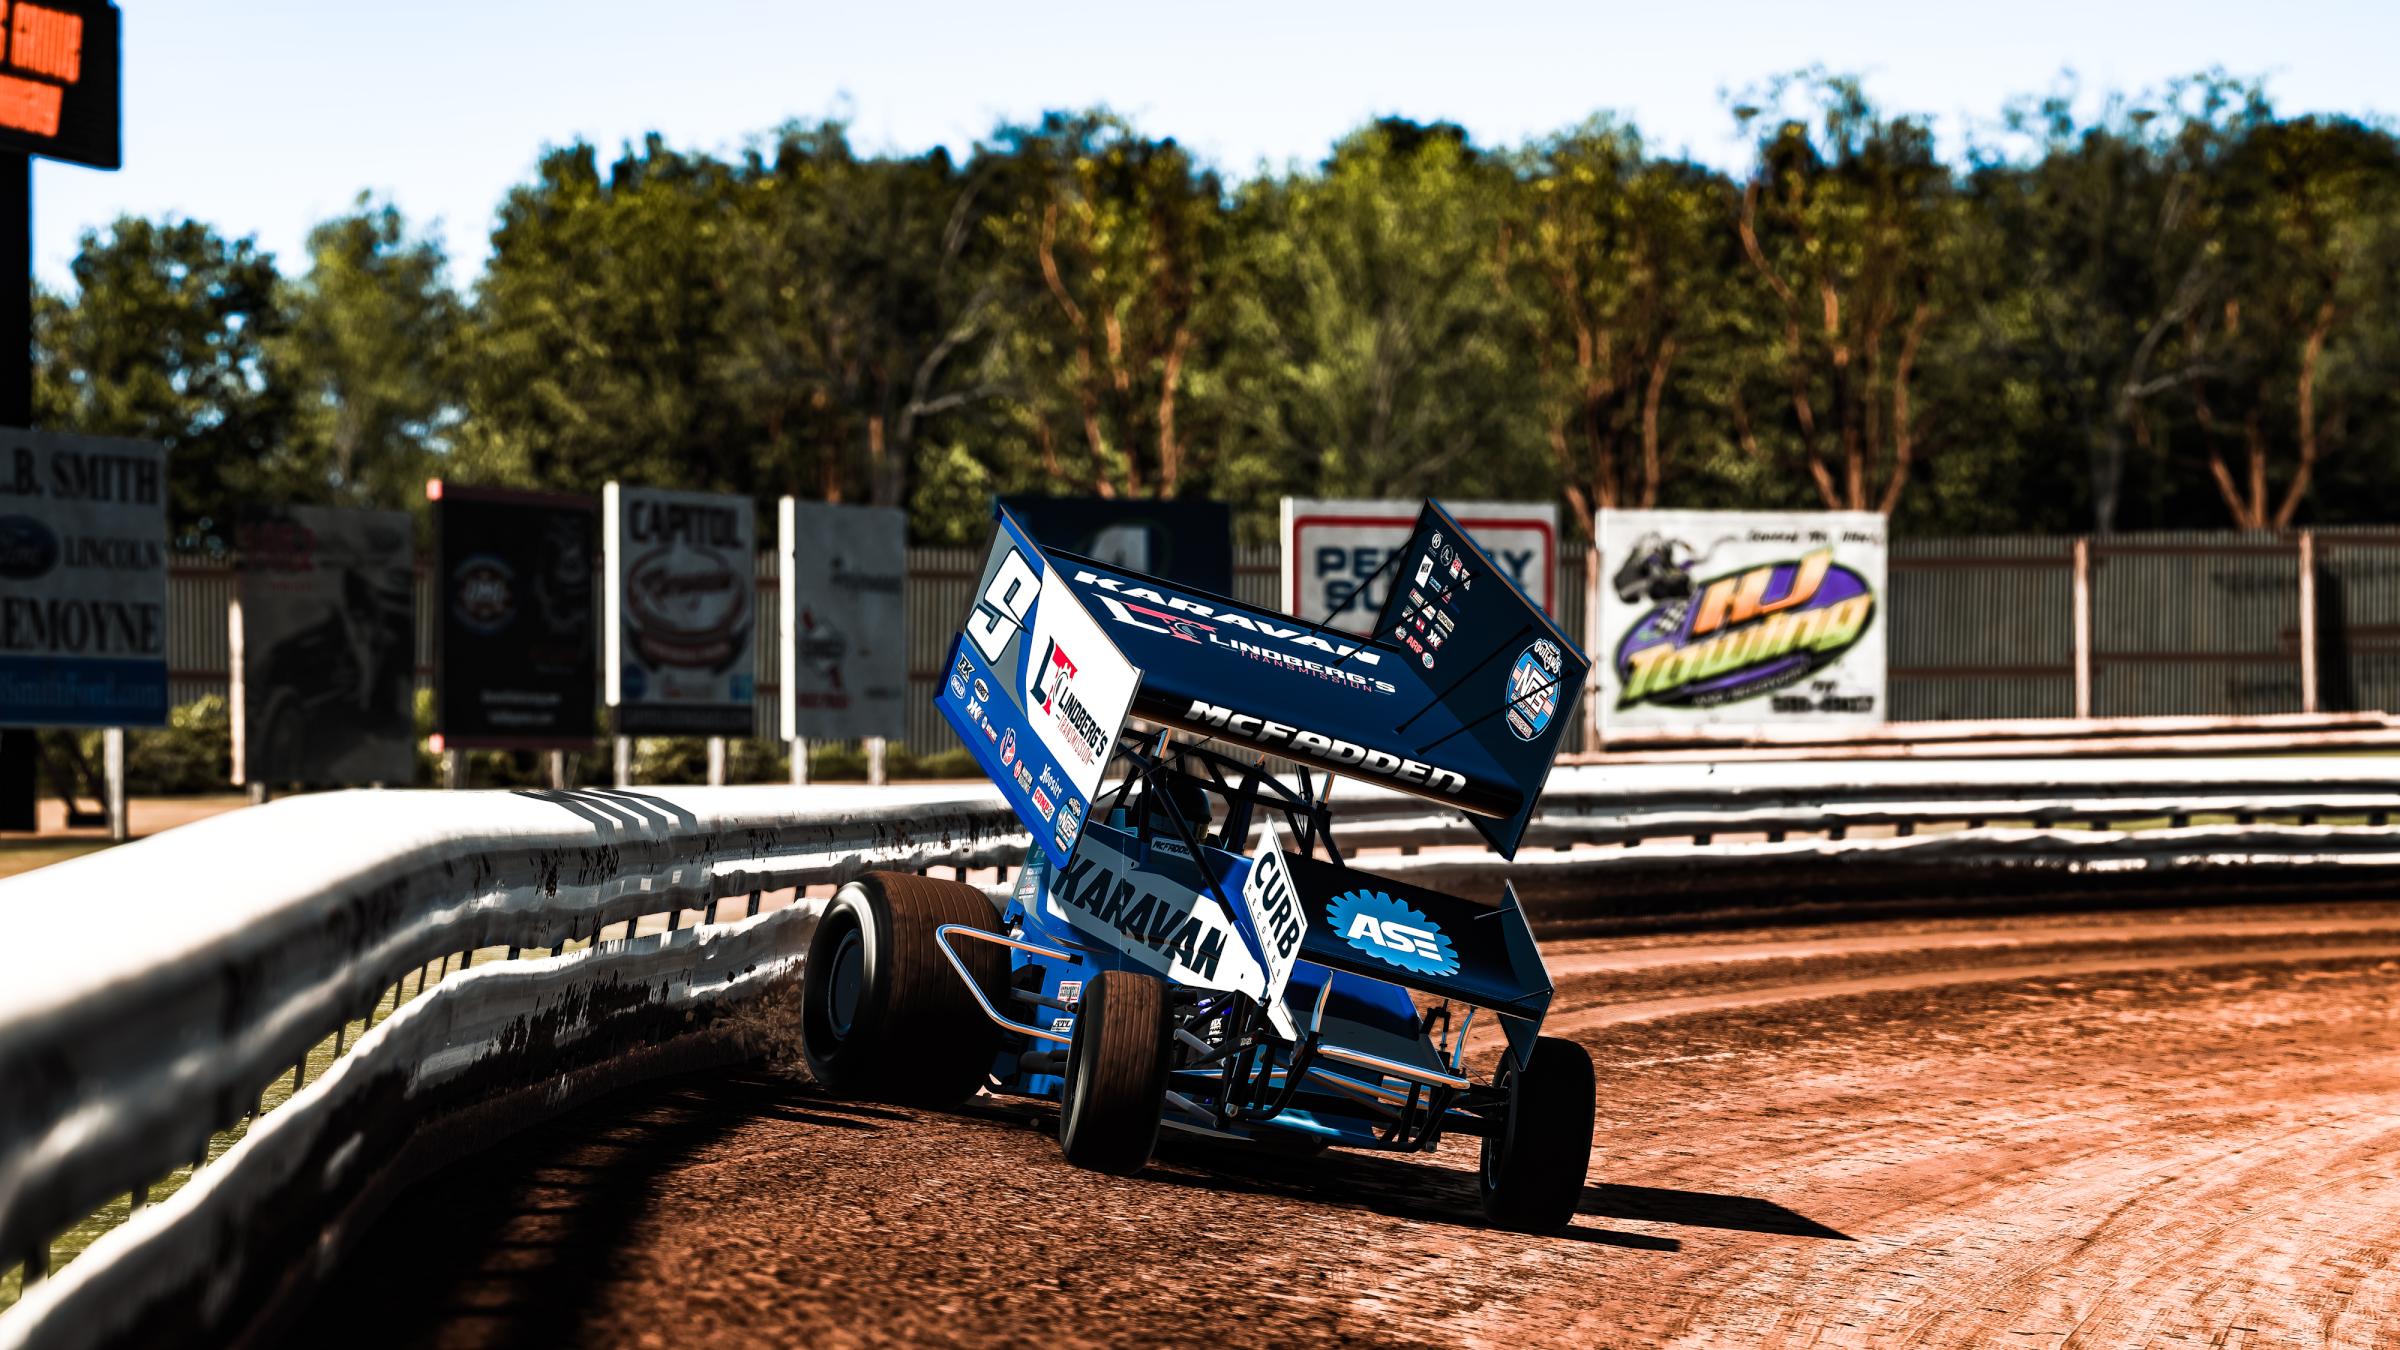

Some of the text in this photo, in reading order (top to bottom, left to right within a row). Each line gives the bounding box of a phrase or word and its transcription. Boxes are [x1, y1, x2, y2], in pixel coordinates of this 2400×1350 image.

[50, 451, 159, 504] SMITH
[628, 499, 743, 548] CAPITOL
[63, 536, 160, 571] LINCOLN
[0, 597, 162, 653] EMOYNE
[966, 545, 1042, 666] 9
[1074, 569, 1381, 666] KARAVAN
[1208, 633, 1397, 695] LINDBERG'S
[1406, 634, 1424, 654] ARP
[1626, 594, 1874, 700] Towing
[1240, 649, 1373, 694] TRANSMISSION
[1057, 686, 1110, 758] LINDBERG'S
[1034, 788, 1051, 811] COMP
[1039, 763, 1063, 800] Hoosier
[1051, 853, 1228, 982] KARAVAN
[1254, 851, 1300, 960] CURB
[1347, 913, 1443, 962] ASE
